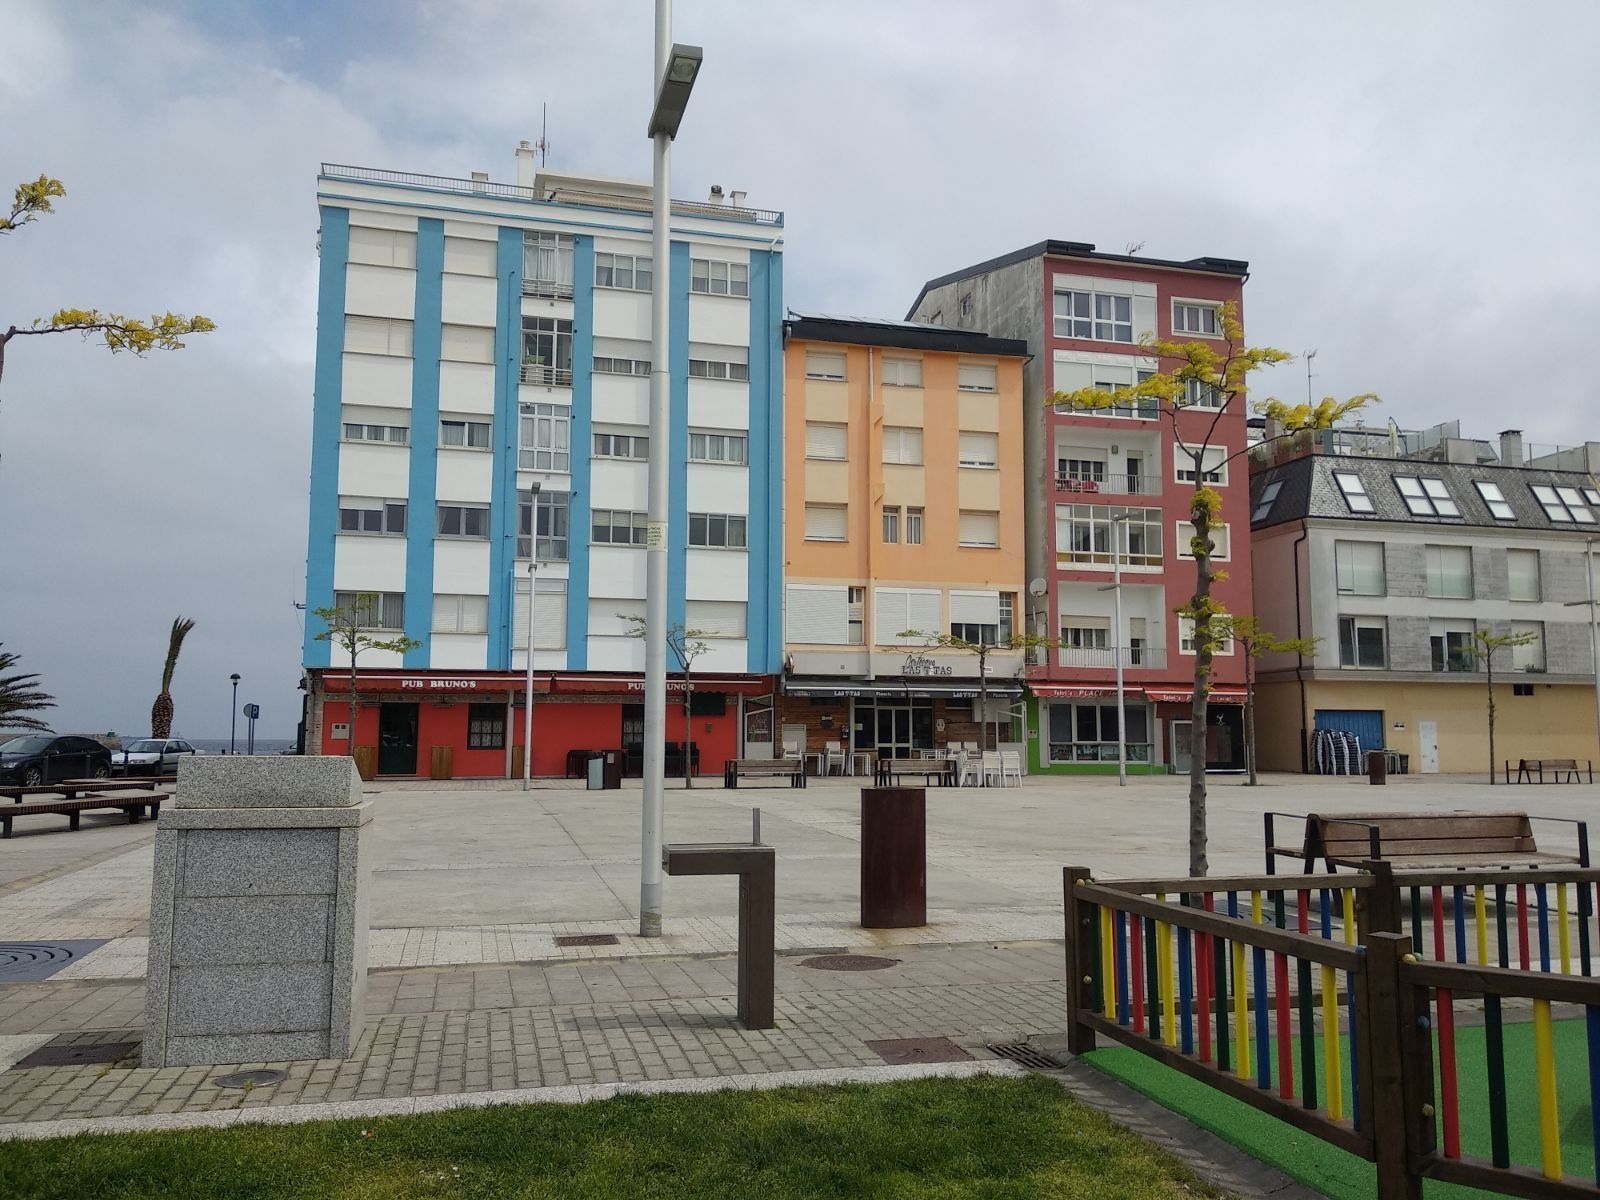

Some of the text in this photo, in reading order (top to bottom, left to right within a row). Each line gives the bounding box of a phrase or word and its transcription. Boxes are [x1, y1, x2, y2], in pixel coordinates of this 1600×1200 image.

[901, 666, 952, 675] LAS TTAS
[401, 680, 476, 689] PUB BRUNO'S
